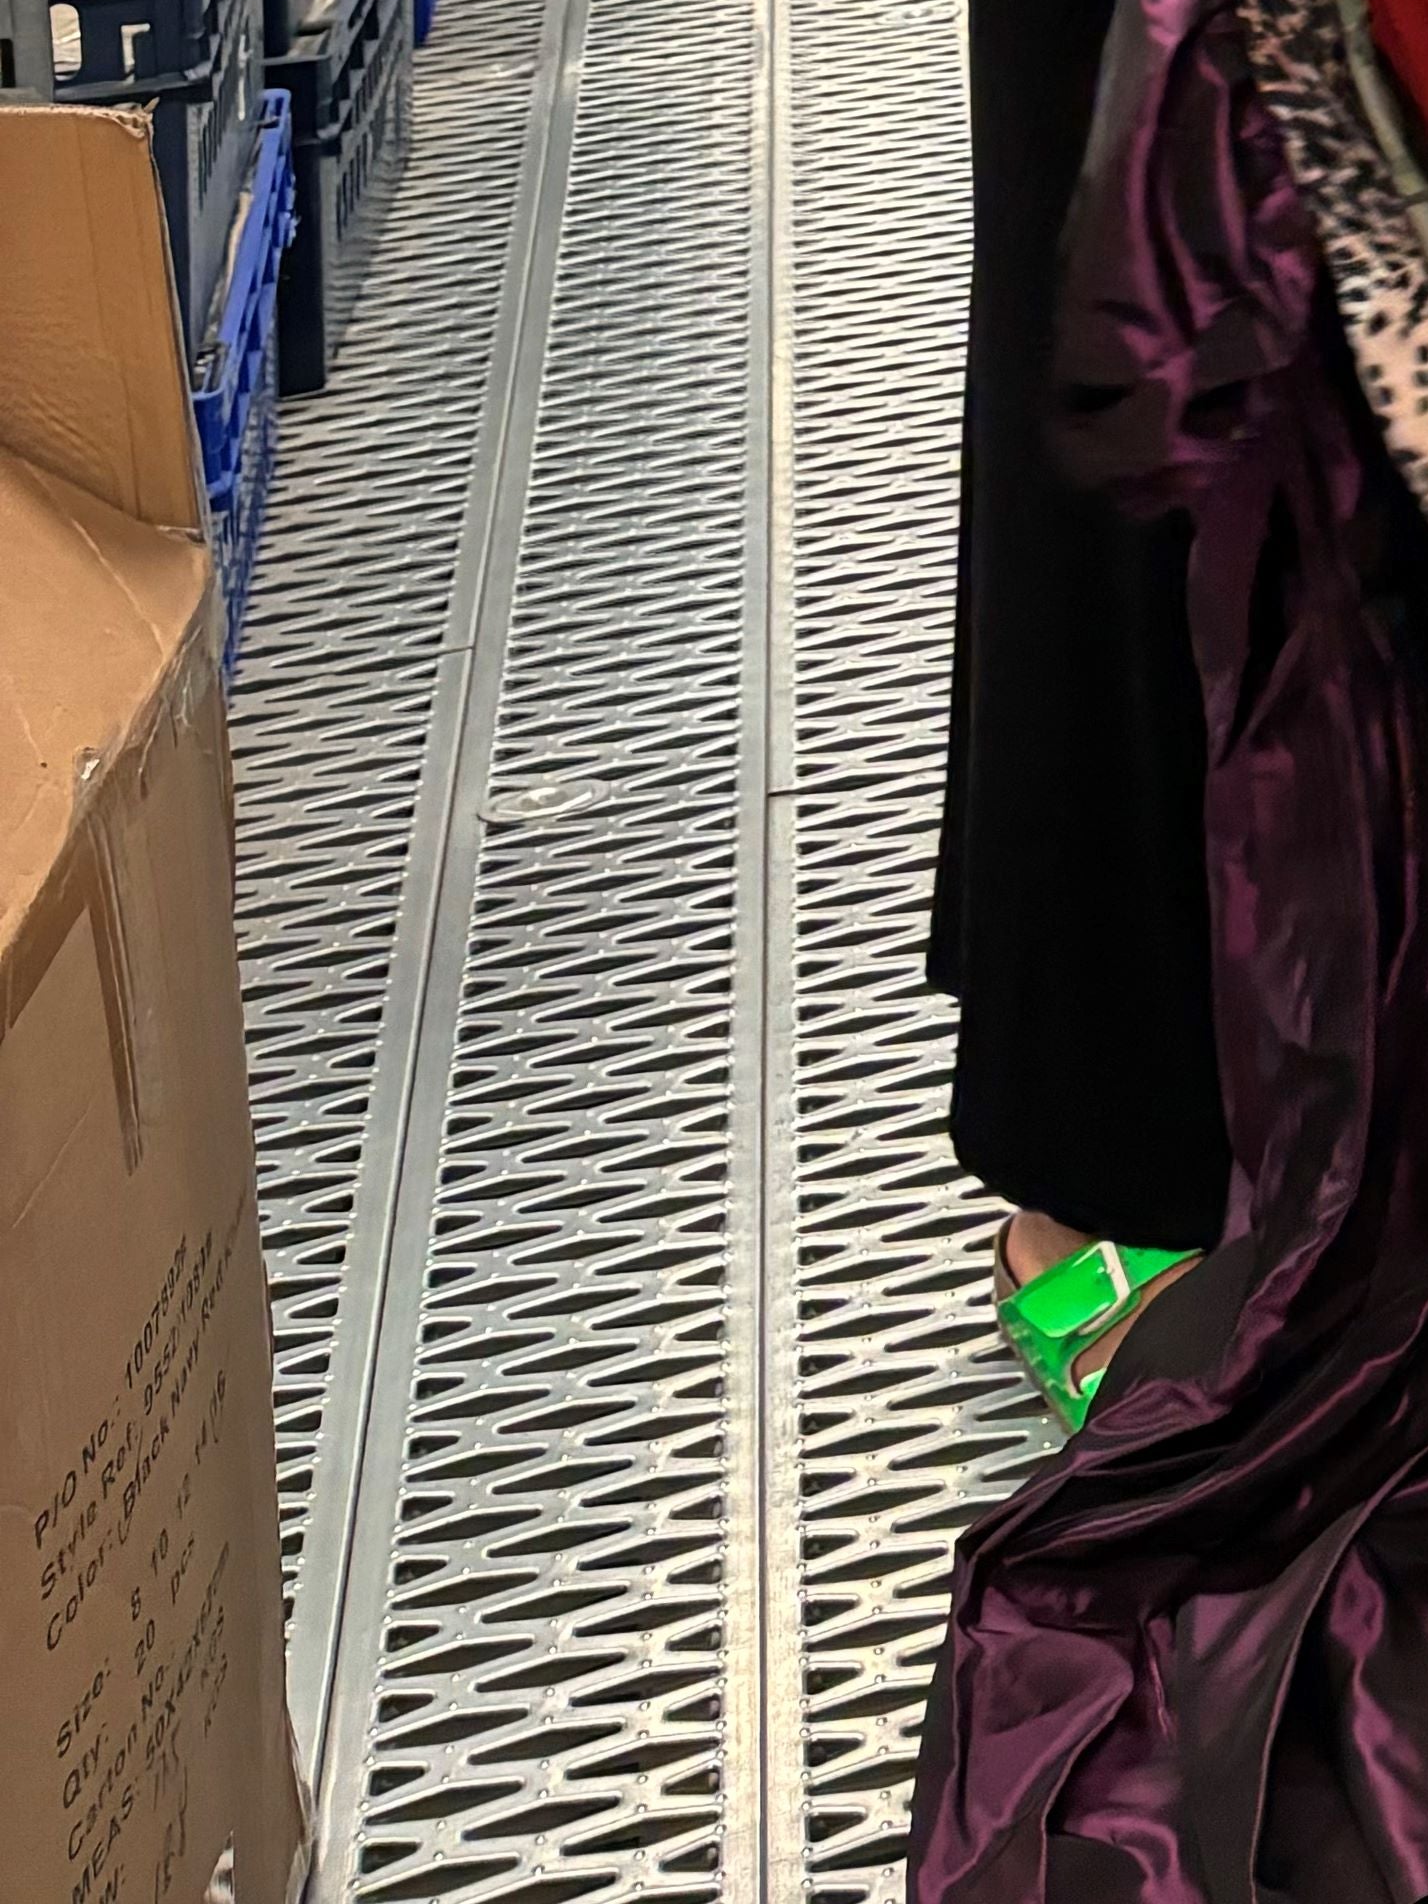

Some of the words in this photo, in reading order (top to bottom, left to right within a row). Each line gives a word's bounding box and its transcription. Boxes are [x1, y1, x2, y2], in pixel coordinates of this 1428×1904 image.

[34, 1470, 77, 1550] P/O
[41, 1500, 97, 1602] Style
[46, 1528, 113, 1652] Color:
[123, 1416, 170, 1520] Black
[170, 1328, 199, 1419] Navy
[56, 1657, 111, 1759] Size:
[131, 1586, 142, 1622] 8
[150, 1527, 169, 1577] 10
[62, 1722, 109, 1810] Qty:
[134, 1618, 155, 1677] 20
[68, 1722, 138, 1862] Carton
[72, 1776, 139, 1904] MEAS:
